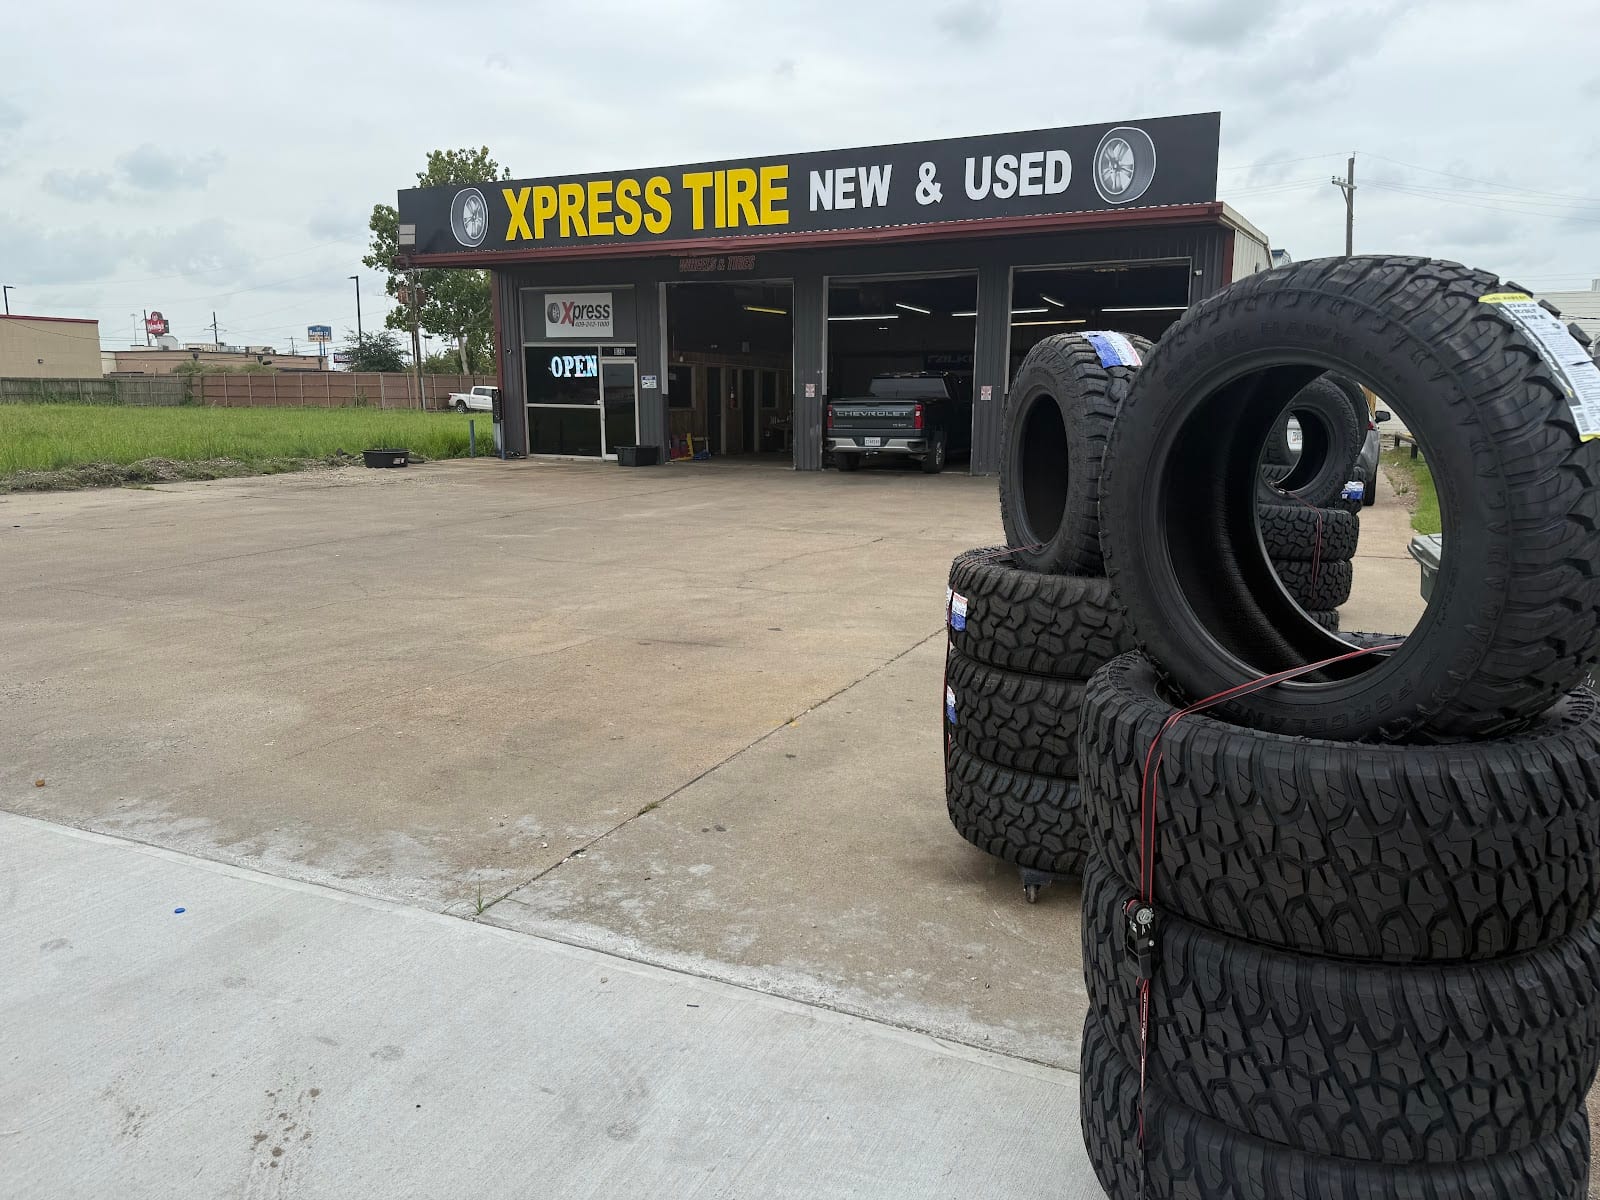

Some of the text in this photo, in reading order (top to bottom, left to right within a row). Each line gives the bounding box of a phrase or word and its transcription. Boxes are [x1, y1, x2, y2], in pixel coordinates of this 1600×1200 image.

[502, 149, 1072, 241] XPRESS TIRE NEW & USED
[560, 301, 610, 327] Xpress
[551, 355, 598, 378] OPEN
